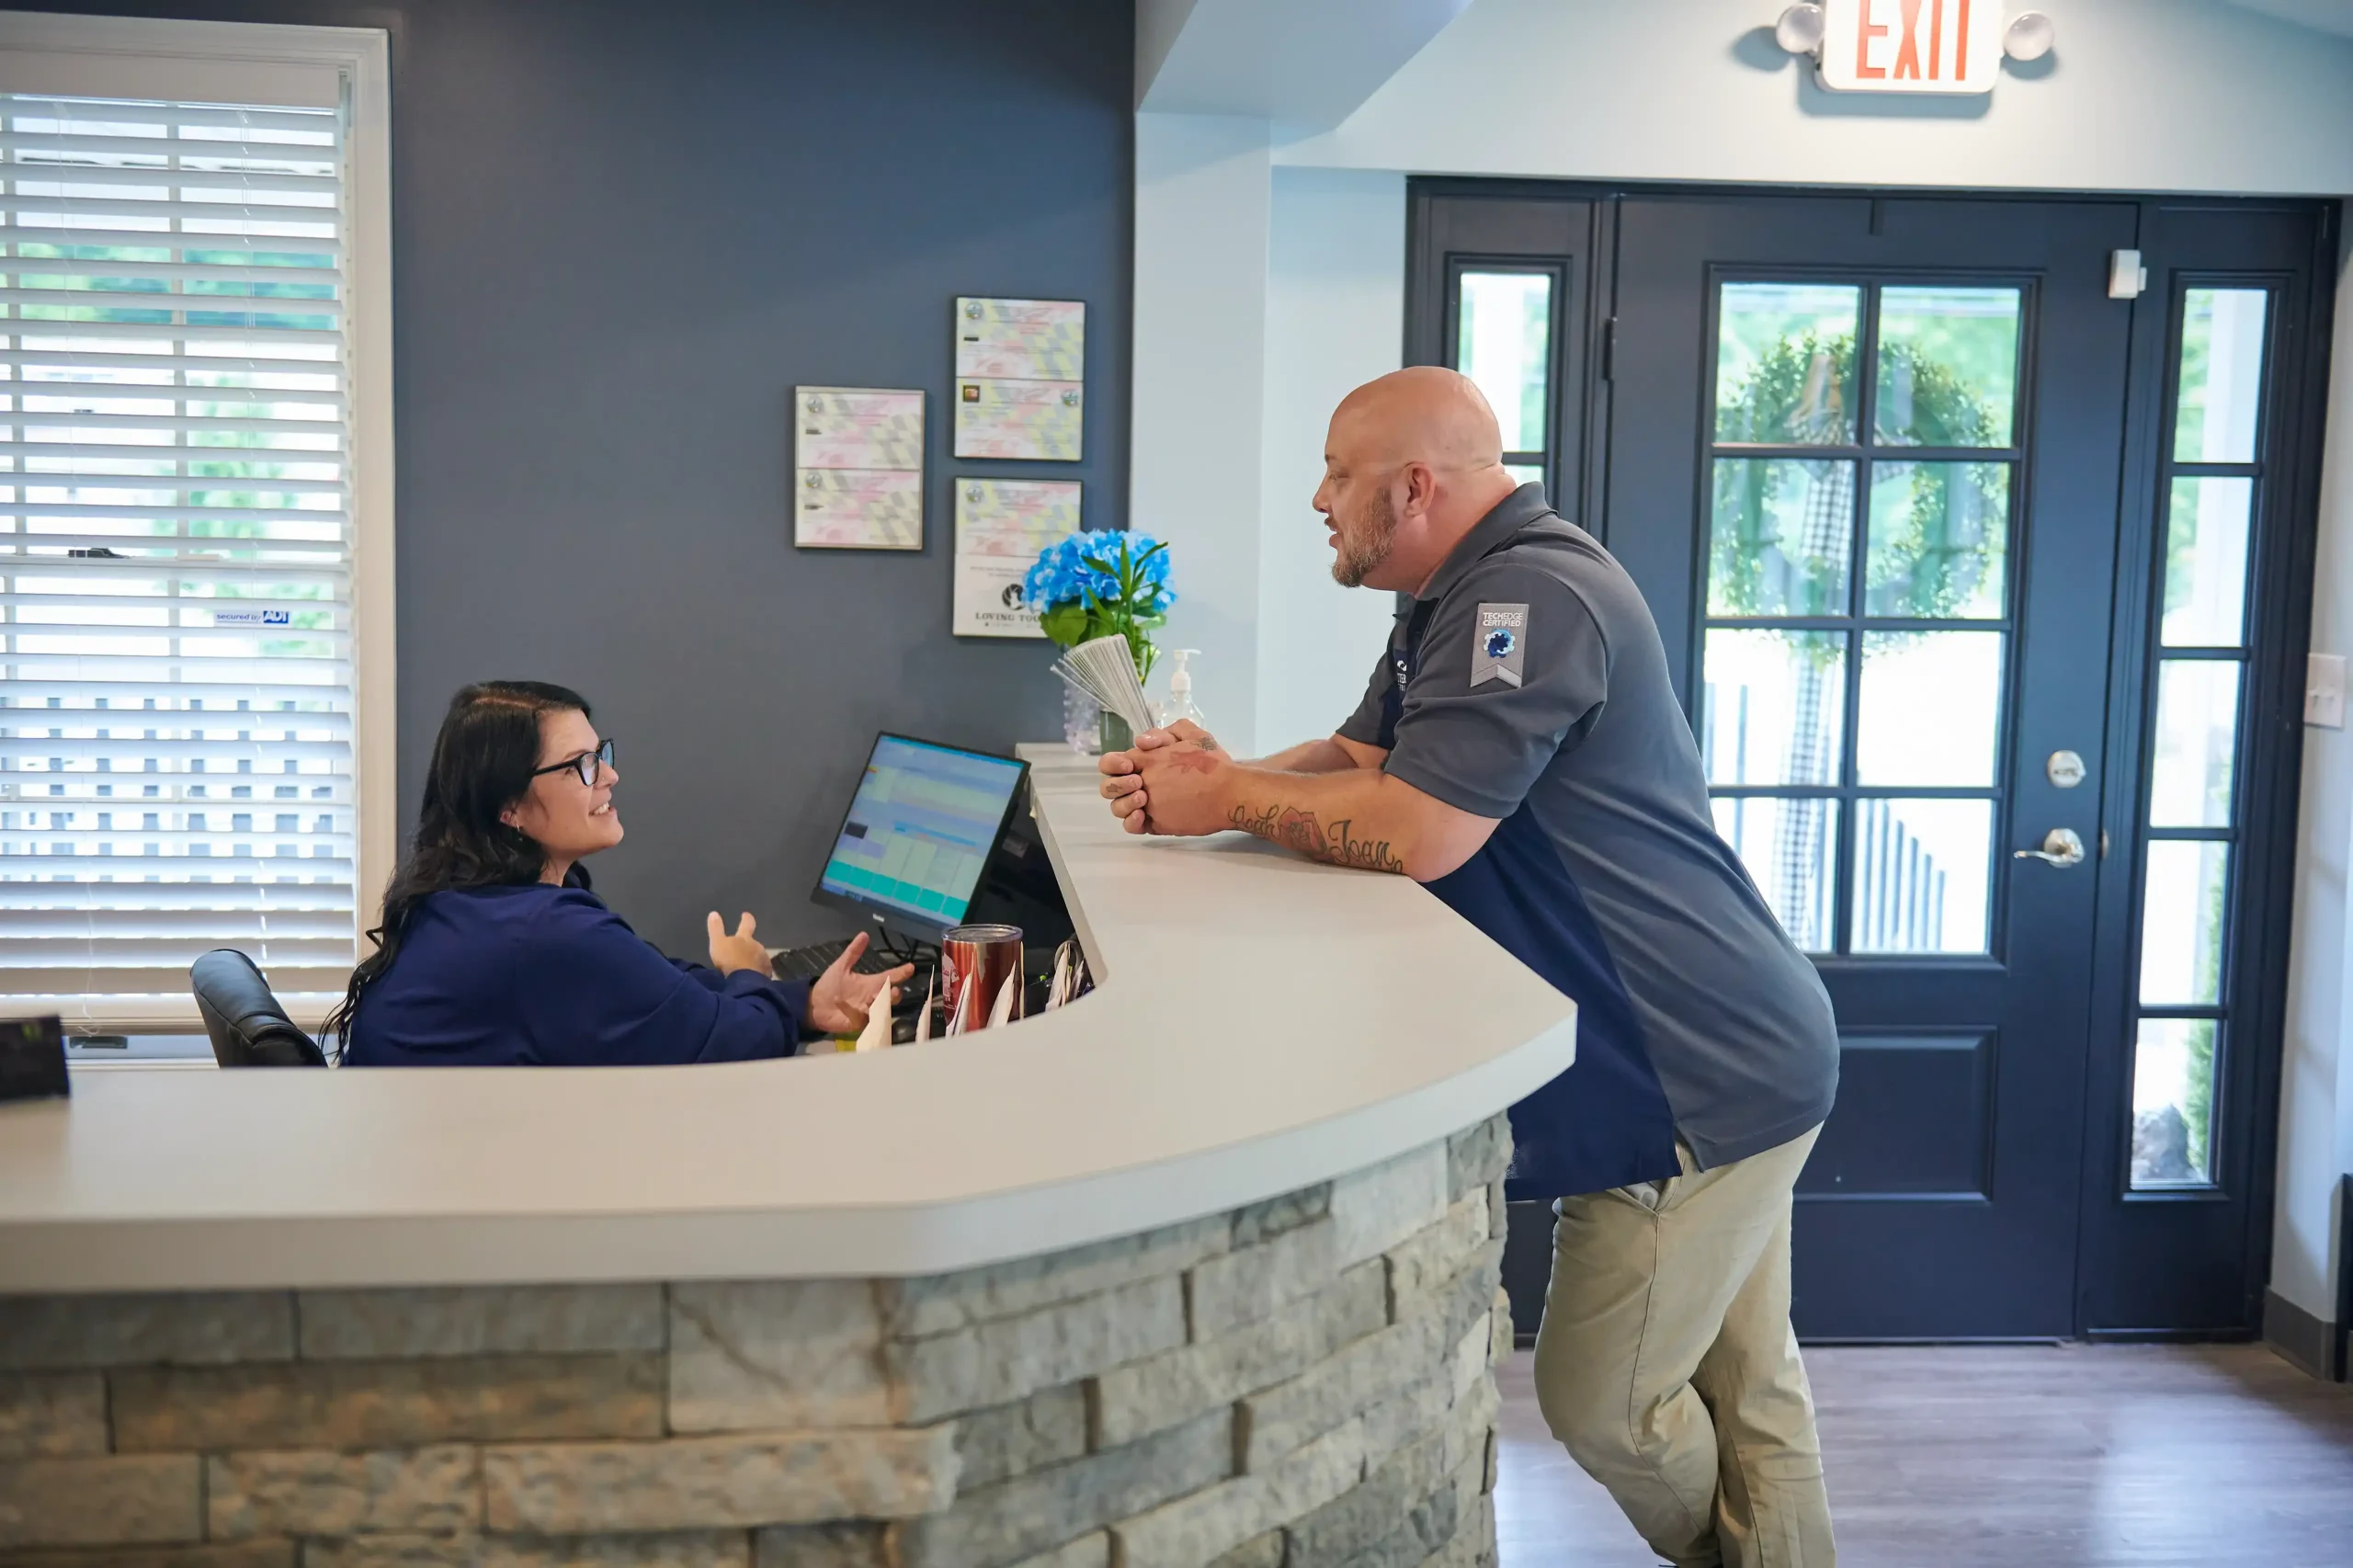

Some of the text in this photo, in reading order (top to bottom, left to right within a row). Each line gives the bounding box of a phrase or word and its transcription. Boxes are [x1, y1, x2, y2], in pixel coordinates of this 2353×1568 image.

[1856, 0, 1970, 81] EXIT
[975, 612, 1040, 622] LOVING TOU
[1483, 612, 1523, 620] TECHEDGE
